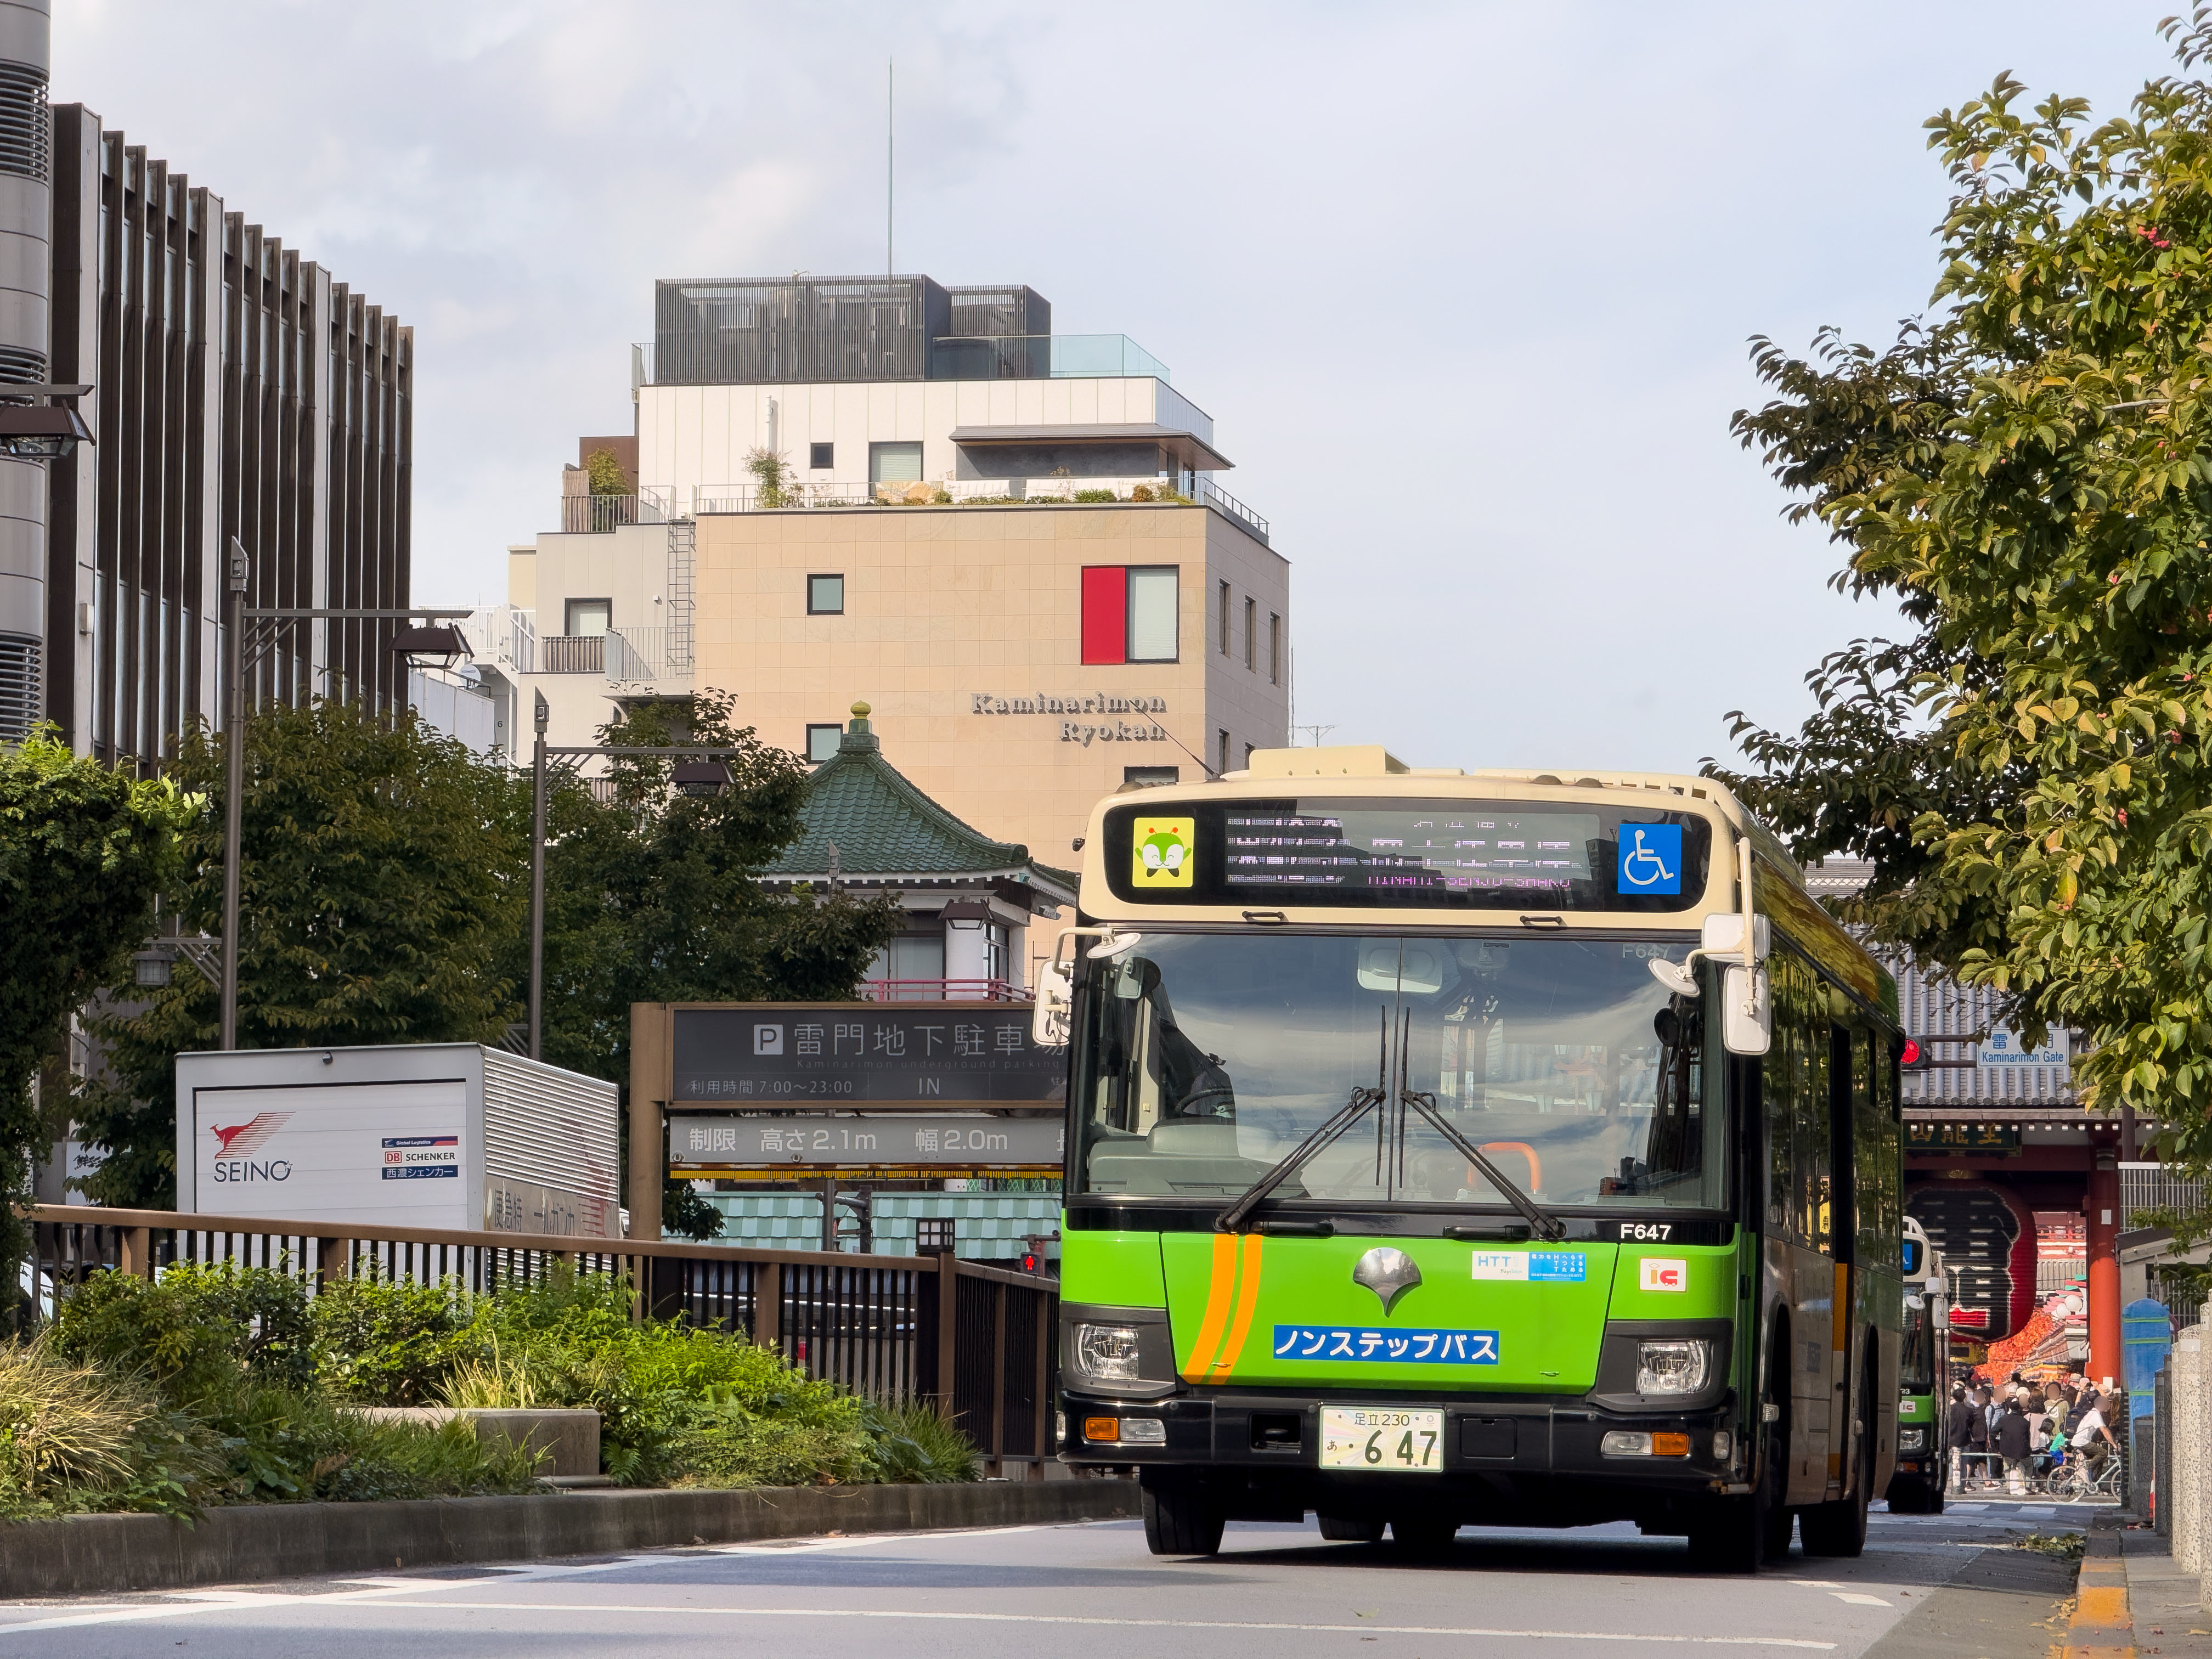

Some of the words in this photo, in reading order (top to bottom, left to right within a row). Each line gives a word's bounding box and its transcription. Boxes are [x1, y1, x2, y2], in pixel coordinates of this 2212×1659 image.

[970, 691, 1167, 714] Kaminarimon
[1059, 718, 1167, 748] Ryokan
[1622, 943, 1671, 959] F647
[797, 1058, 893, 1069] Kaminarimon
[1982, 1051, 2039, 1063] Kaminarimon
[2043, 1050, 2064, 1063] Gate
[917, 1077, 940, 1094] IN
[689, 1128, 736, 1152] 制限
[387, 1153, 400, 1161] DB
[405, 1152, 455, 1161] SCHENKER
[213, 1160, 292, 1182] SEINO
[386, 1167, 454, 1178] 西濃シェンカー
[1621, 1224, 1671, 1240] F647
[1478, 1255, 1511, 1267] HTT
[1276, 1330, 1497, 1360] ノンステップバス
[1327, 1440, 1338, 1452] あ
